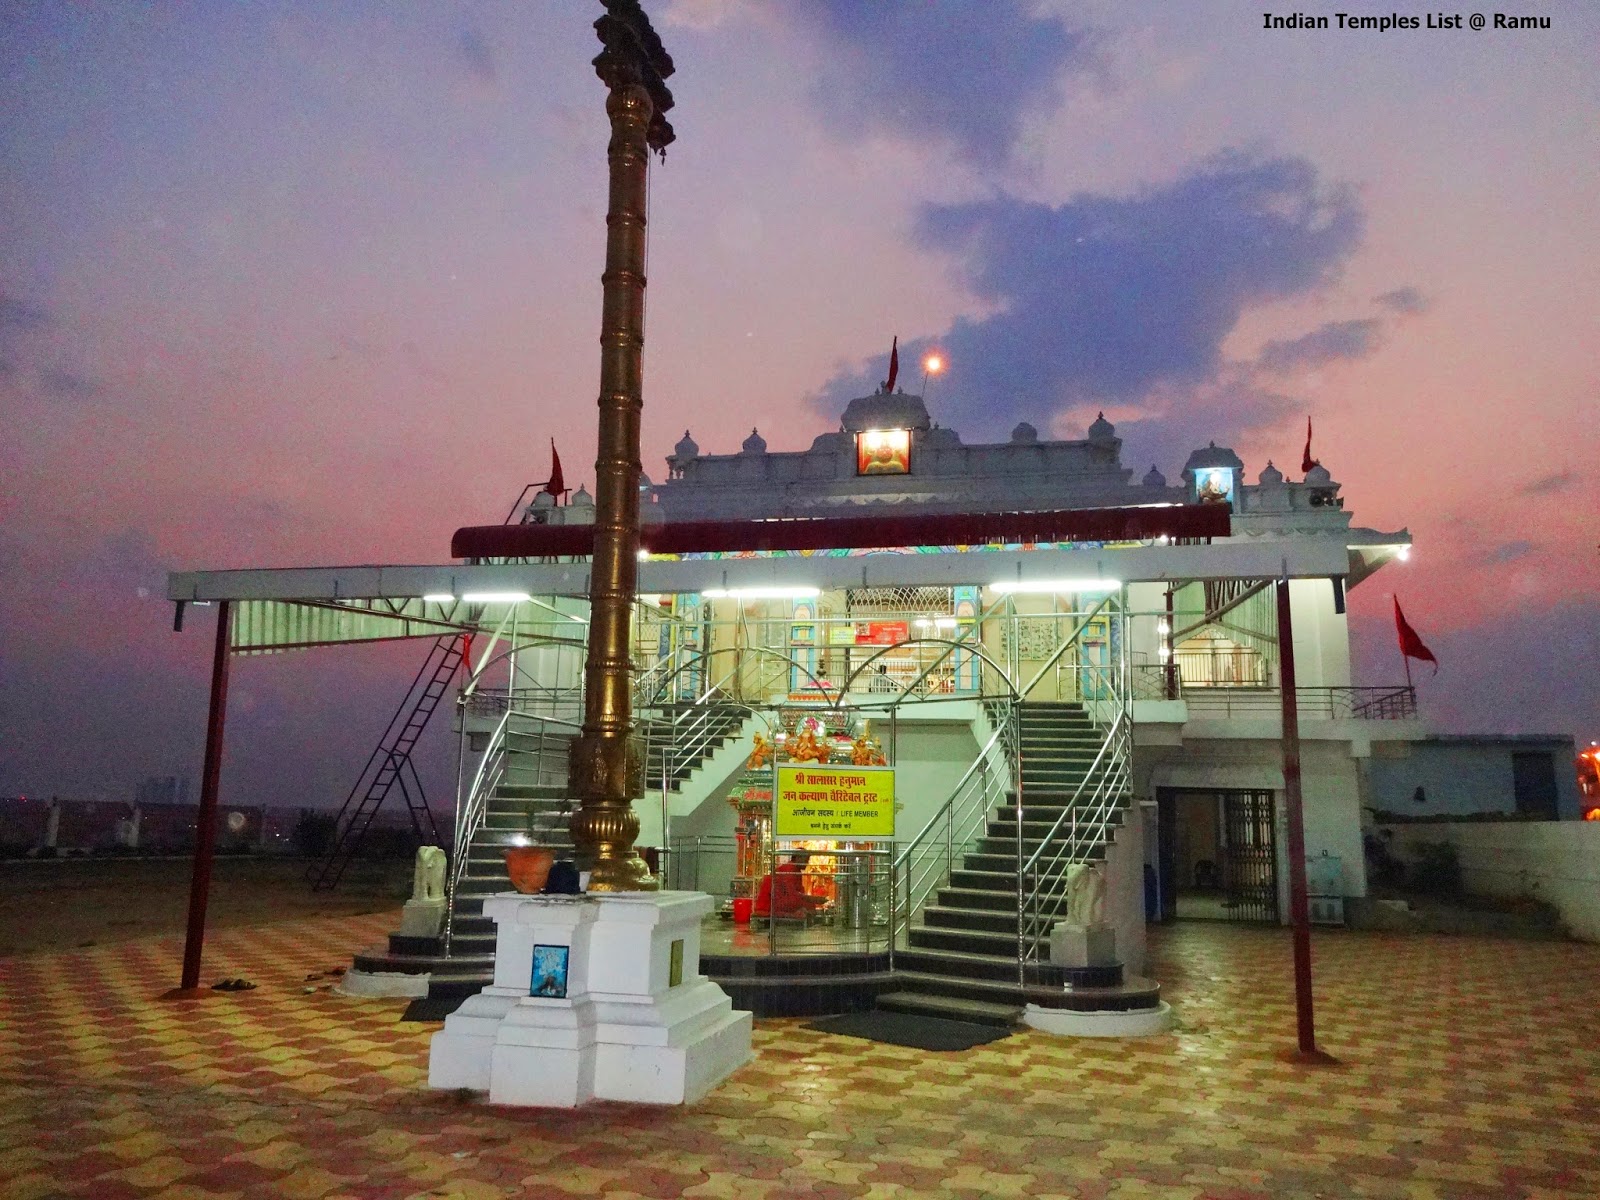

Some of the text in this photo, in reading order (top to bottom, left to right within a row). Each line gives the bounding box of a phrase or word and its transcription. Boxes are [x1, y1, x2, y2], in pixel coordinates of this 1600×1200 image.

[795, 772, 866, 788] श्री सालासर हनुमान
[783, 791, 796, 801] जन
[798, 791, 828, 802] कल्याण
[830, 789, 861, 802] चैरिटेबल
[792, 807, 816, 817] आजीवन
[817, 809, 834, 817] सदस्य
[854, 810, 879, 818] MEMBER
